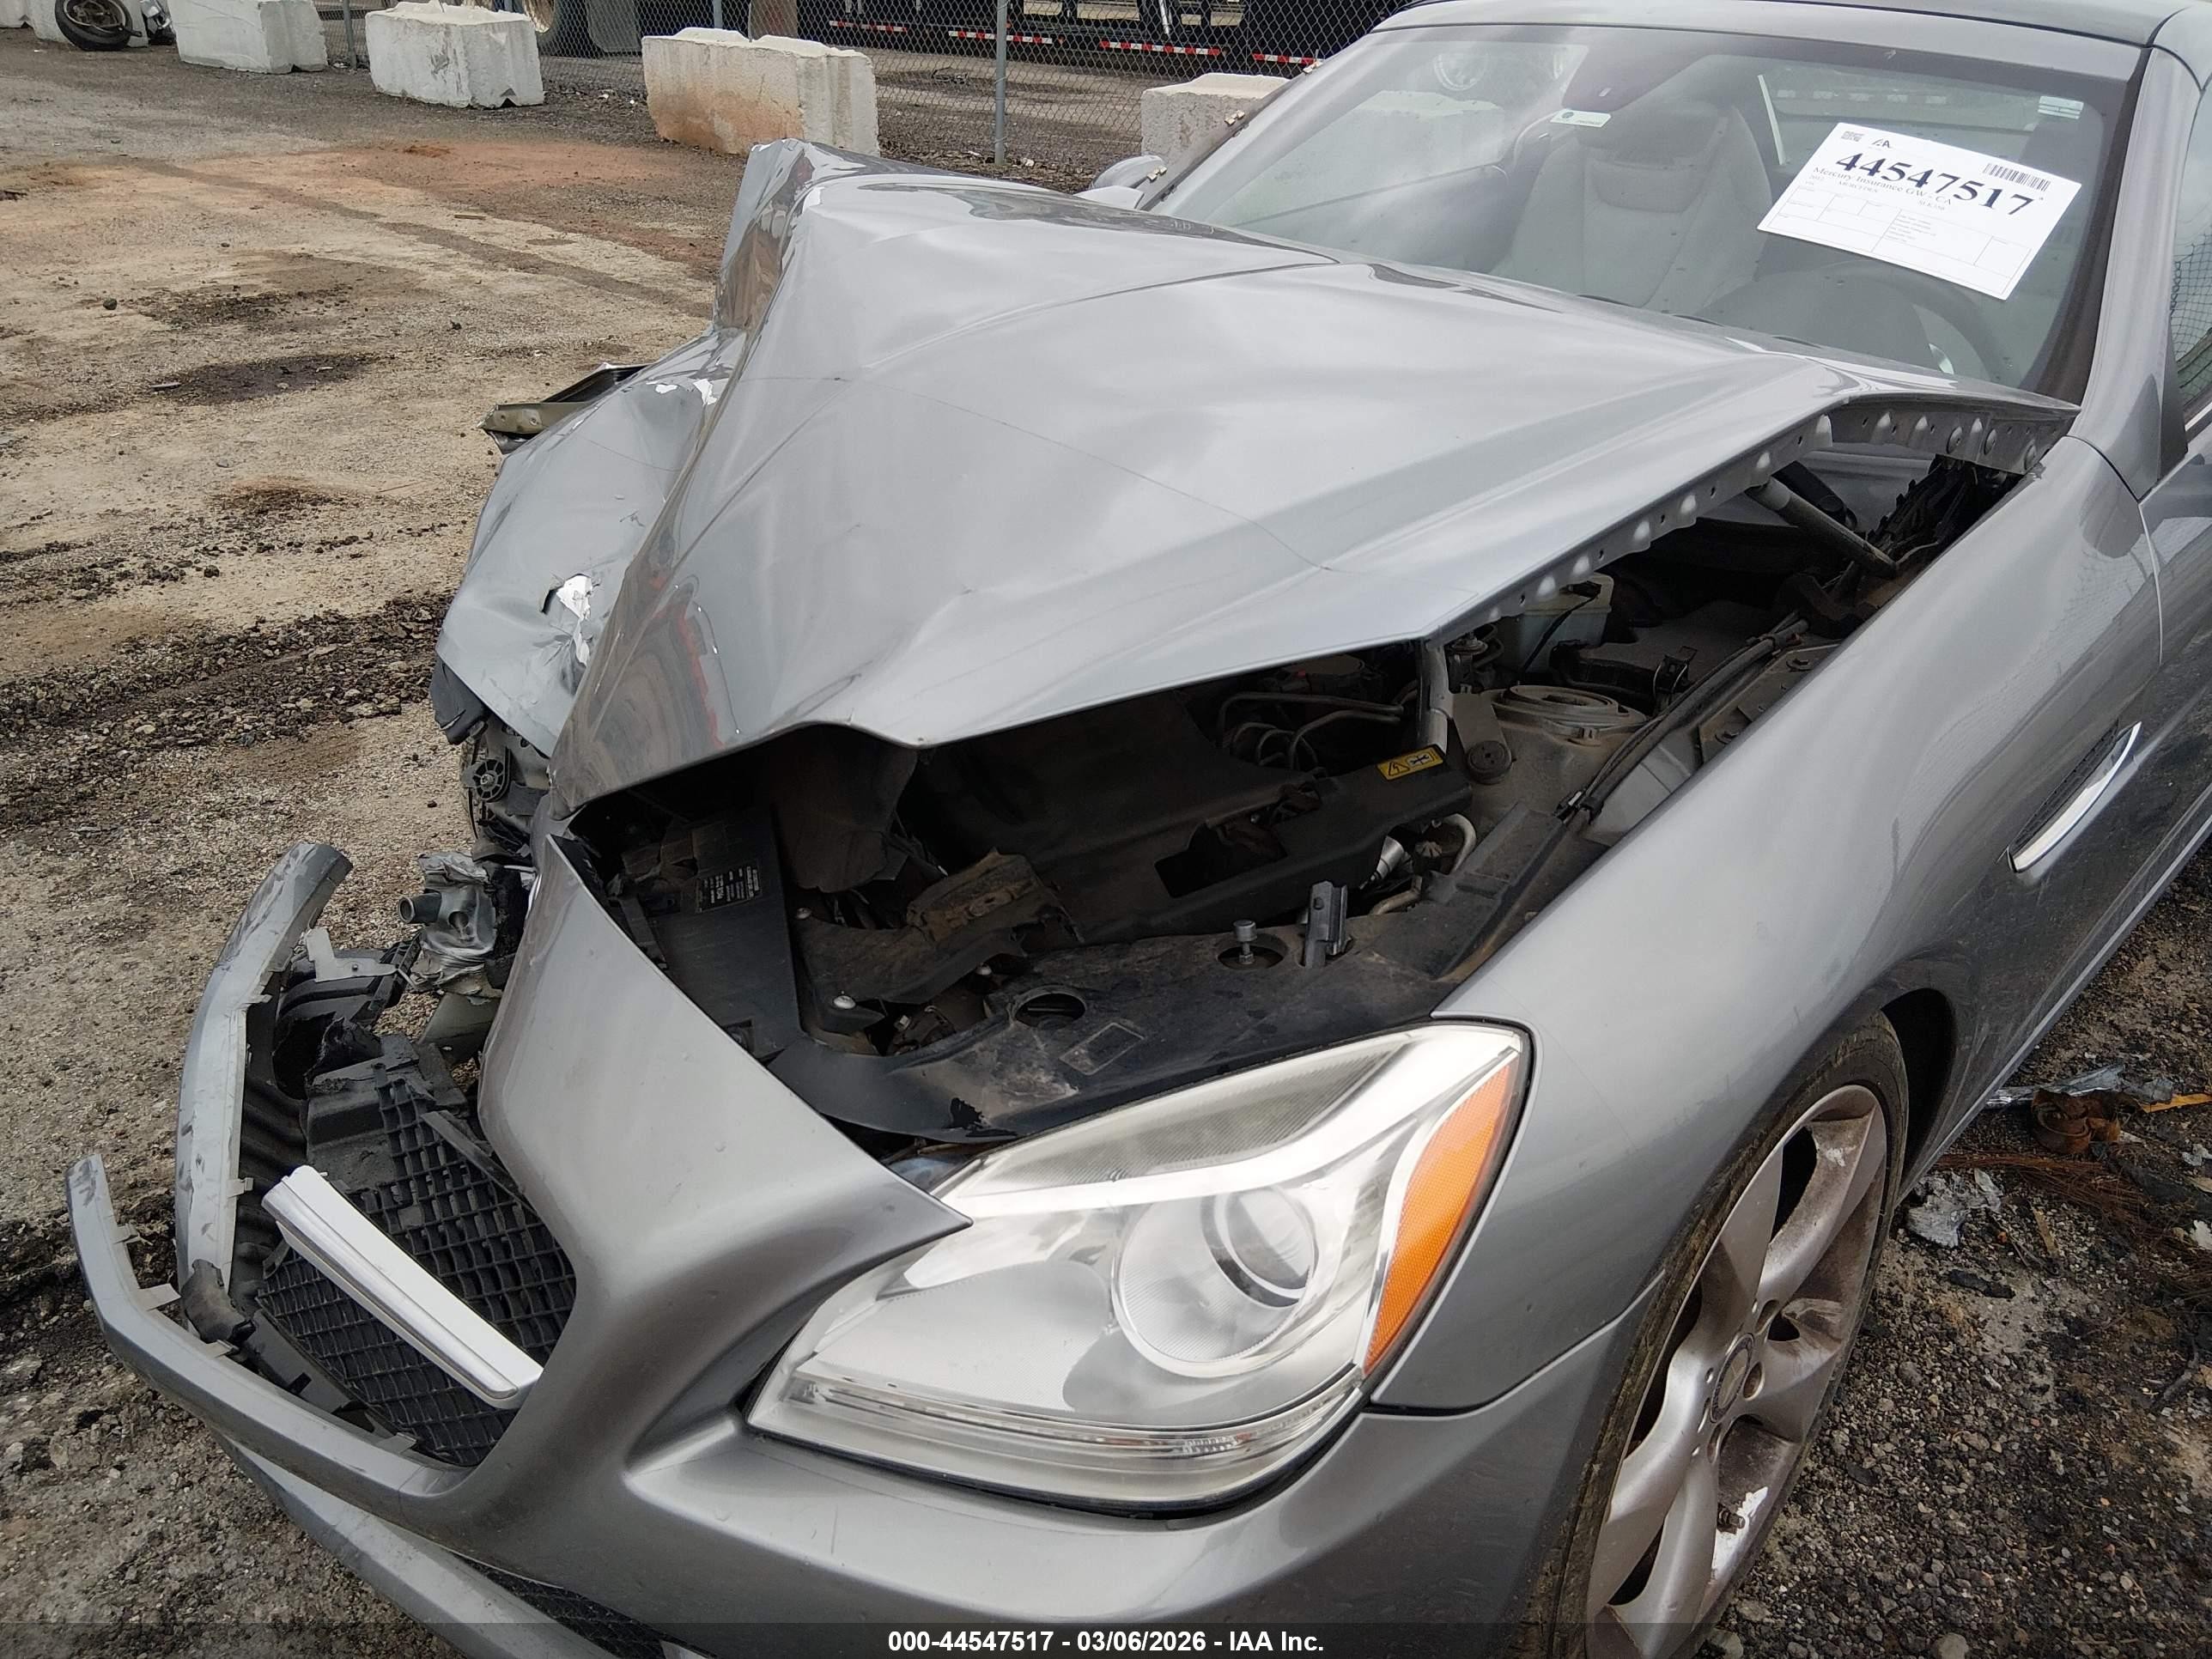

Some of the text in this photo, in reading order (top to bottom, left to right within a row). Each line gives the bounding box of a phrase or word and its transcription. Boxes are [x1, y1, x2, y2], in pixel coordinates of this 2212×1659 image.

[1813, 166, 1854, 181] Mercury
[1856, 175, 1904, 192] Insurance
[1905, 187, 1928, 198] GW
[1935, 195, 1952, 205] CA
[1835, 152, 2034, 216] 44547517
